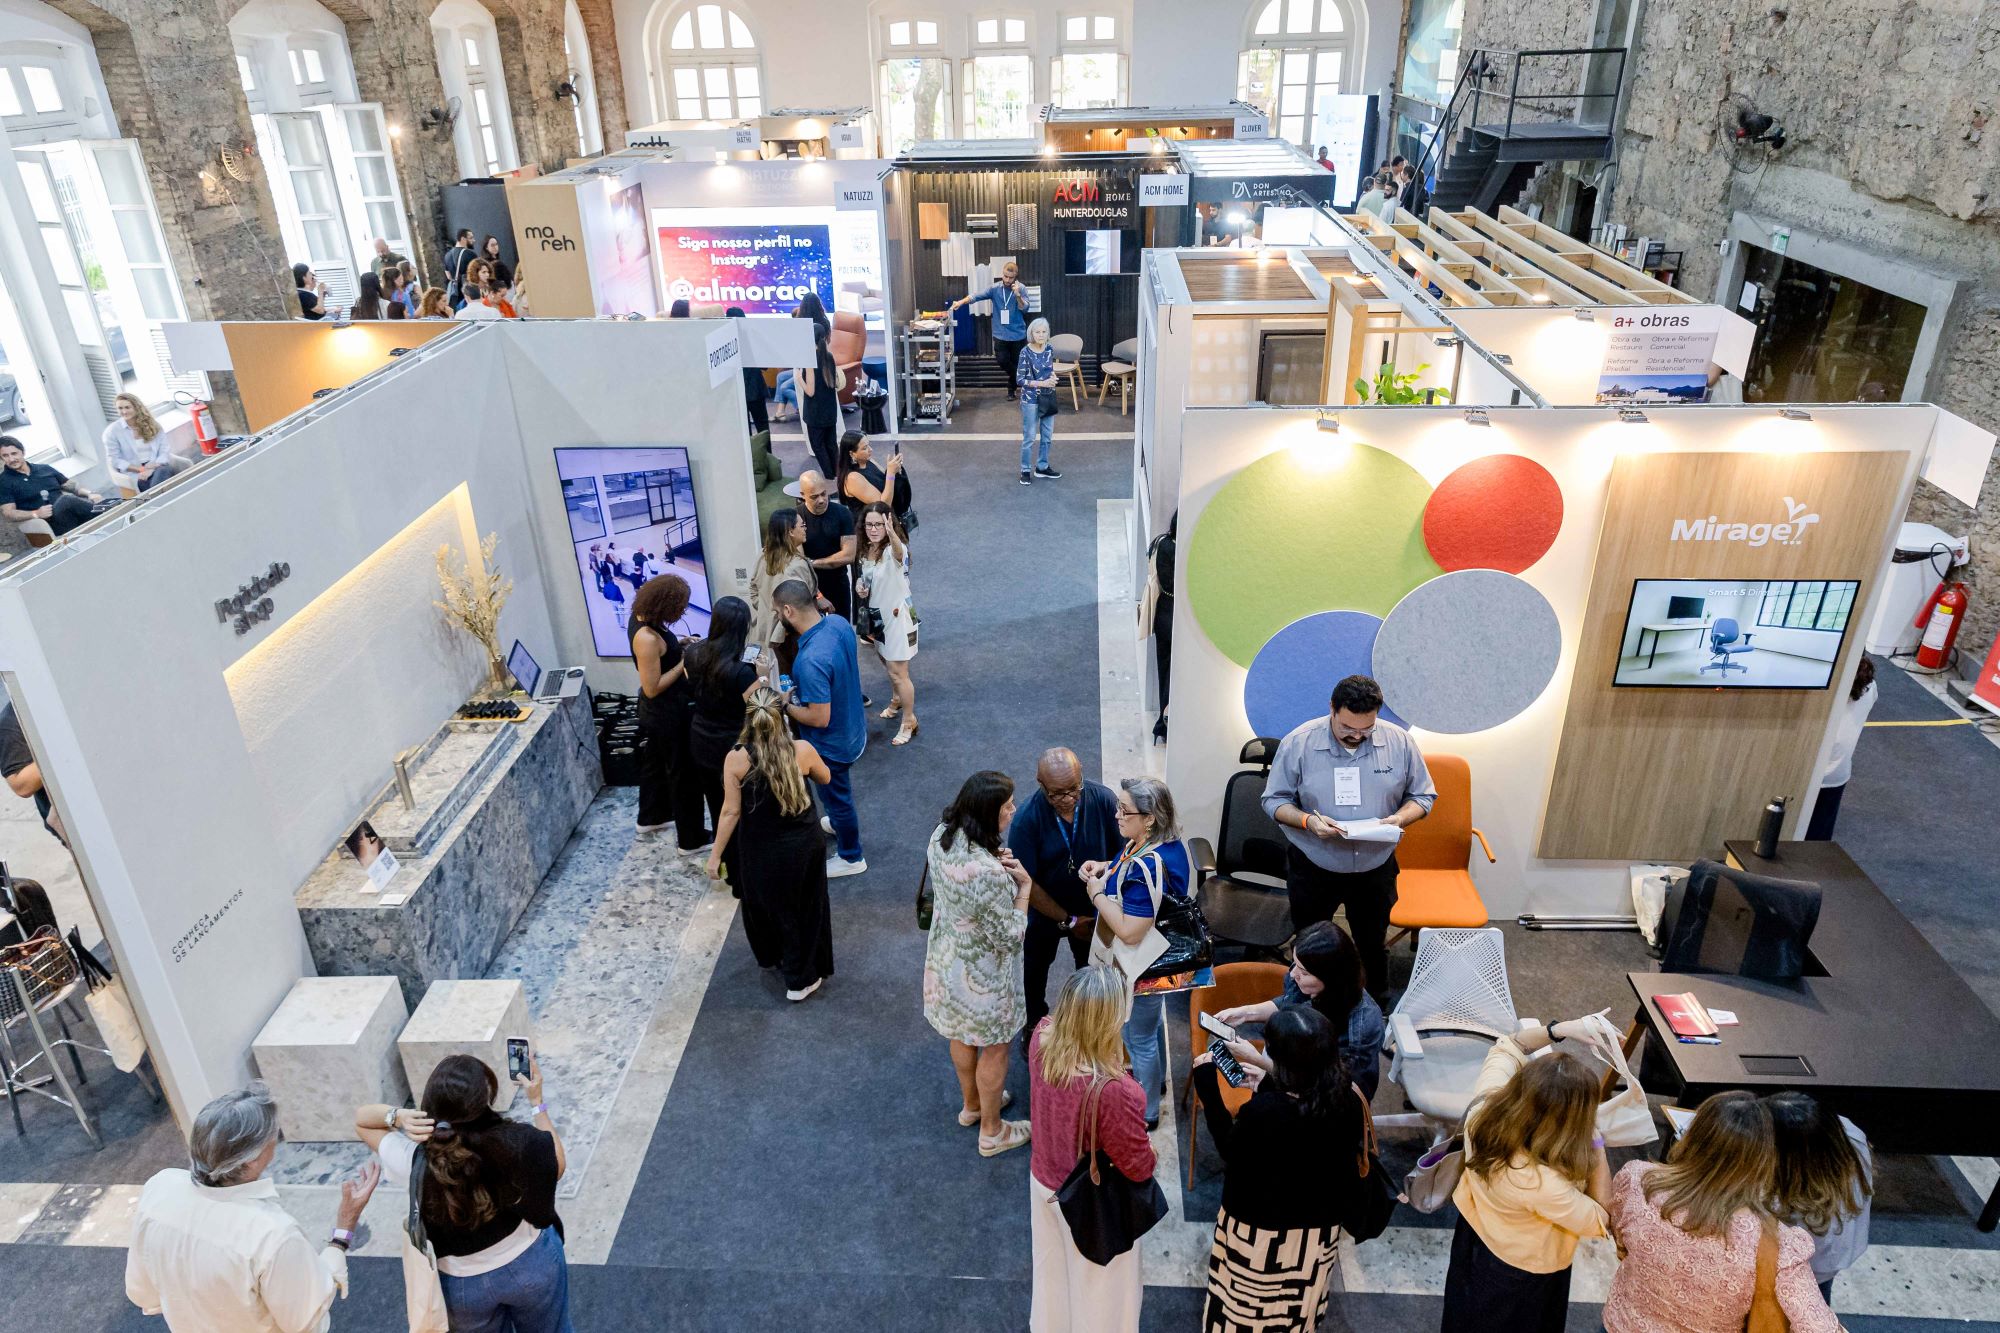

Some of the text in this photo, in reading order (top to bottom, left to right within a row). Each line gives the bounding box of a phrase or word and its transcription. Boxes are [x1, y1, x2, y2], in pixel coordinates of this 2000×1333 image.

[743, 168, 803, 181] NATUZZ
[843, 190, 874, 201] NATUZZI
[1054, 181, 1131, 202] ACM HOME
[1144, 185, 1184, 196] ACM HOME
[1053, 207, 1128, 218] HUNTERDOUGLAS
[678, 235, 812, 251] Siga nosso perfil no
[1614, 313, 1690, 328] a+ obras
[709, 338, 739, 369] PORTOBELLO
[1670, 515, 1792, 547] Mirage
[1708, 588, 1738, 596] Smart
[176, 948, 187, 963] OS
